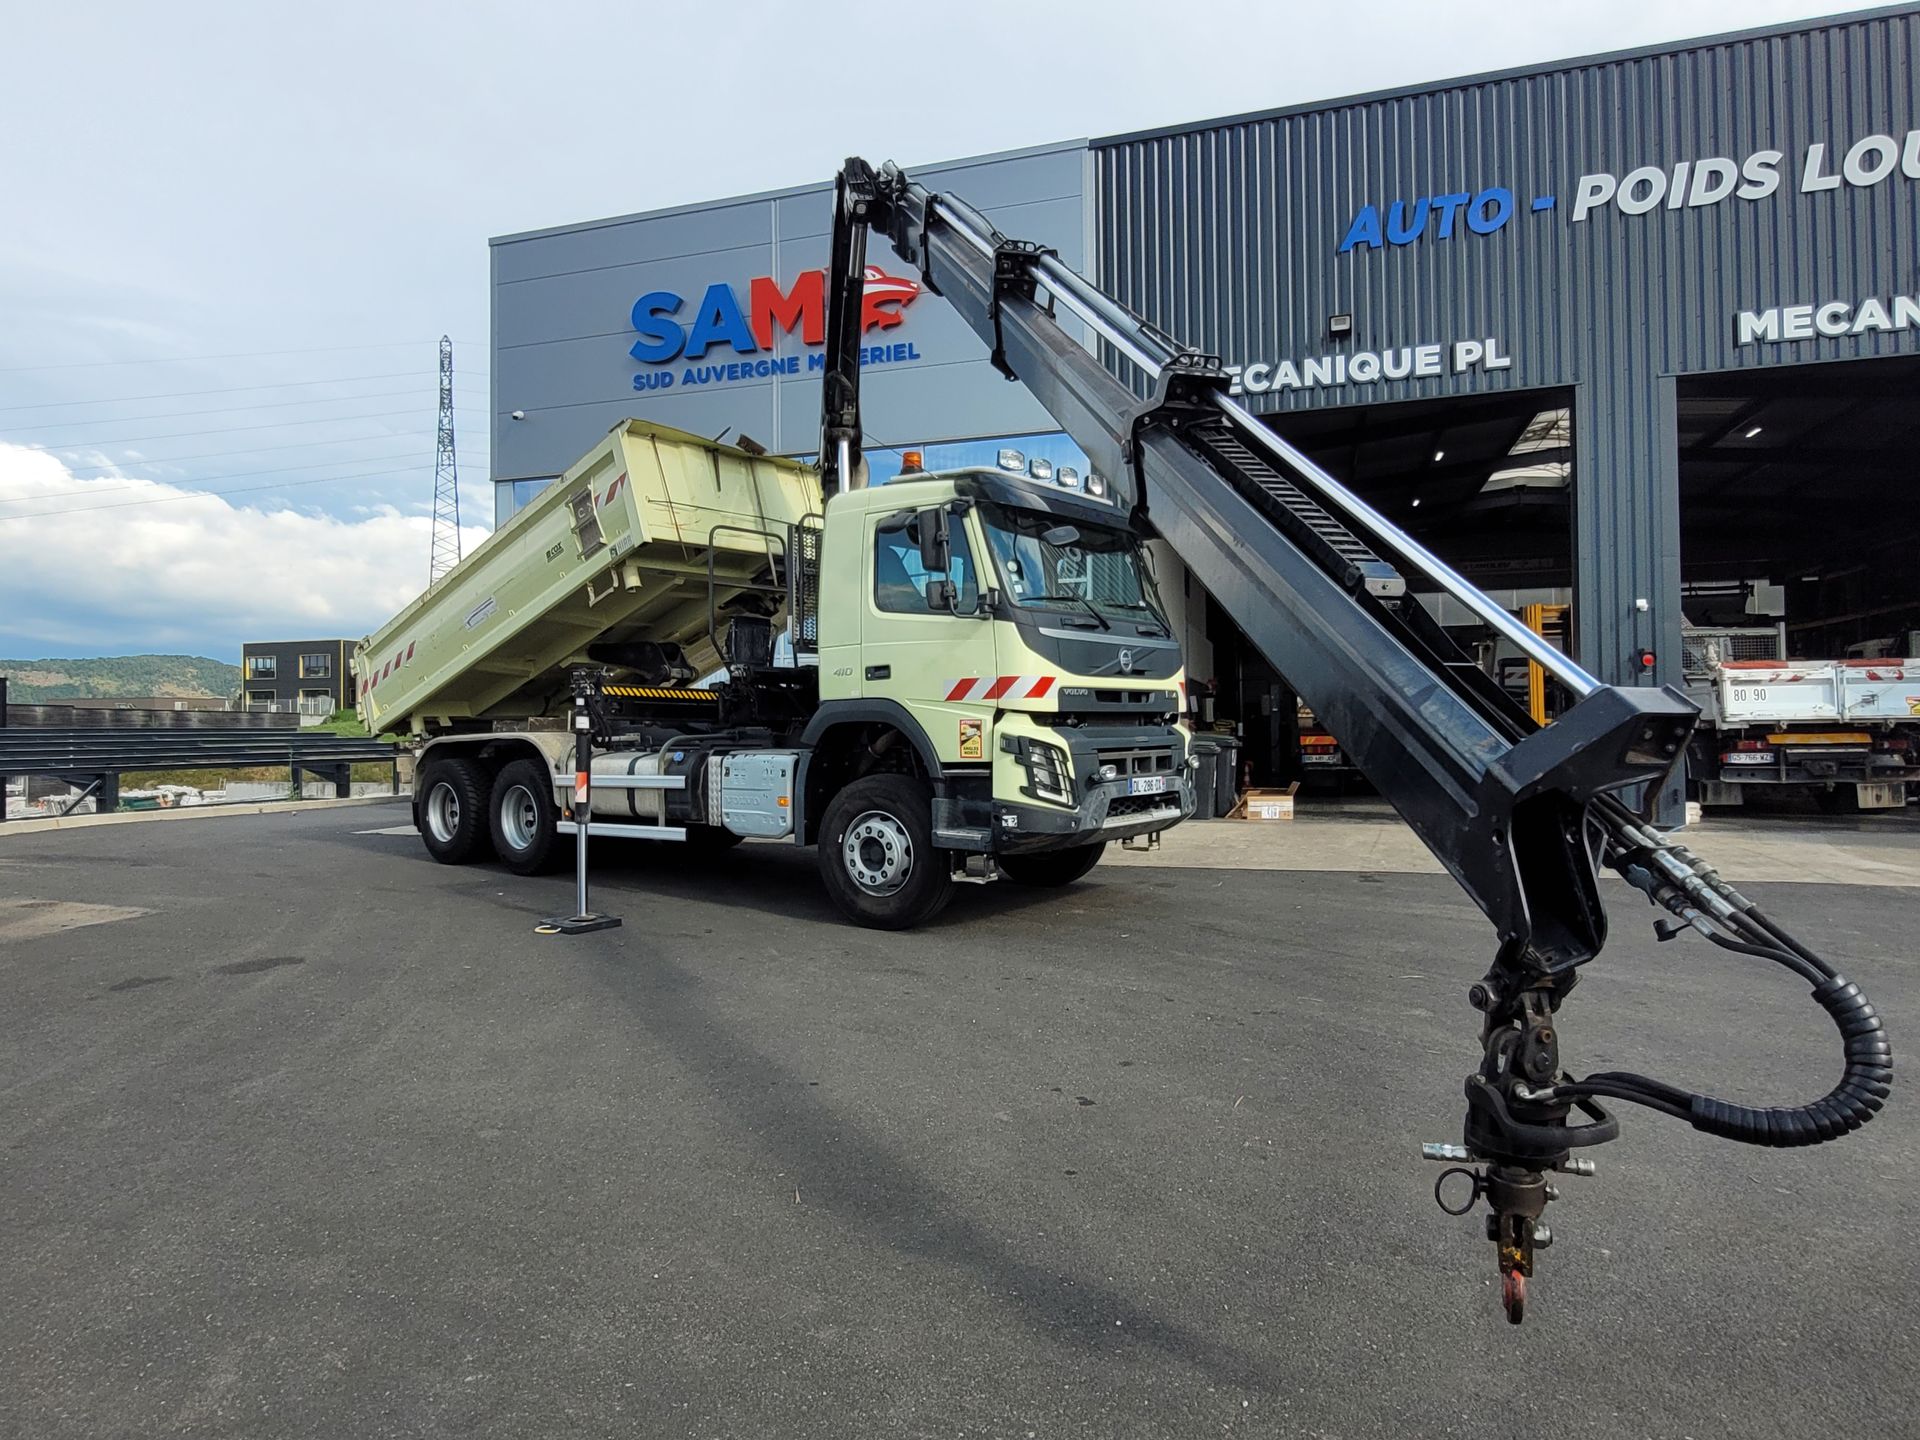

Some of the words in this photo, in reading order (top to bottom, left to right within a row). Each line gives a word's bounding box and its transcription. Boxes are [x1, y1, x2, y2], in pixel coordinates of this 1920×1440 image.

[1339, 187, 1513, 253] AUTO
[1572, 150, 1784, 222] POIDS
[629, 269, 825, 364] SAM
[1740, 295, 1920, 343] MECAN
[633, 371, 674, 391] SUD
[682, 356, 800, 385] AUVERGNE
[808, 342, 921, 371] MERIEL
[1222, 343, 1441, 395] ECANIQUE
[1455, 338, 1511, 371] PL
[833, 667, 854, 677] 410
[1733, 689, 1747, 702] 80
[1753, 688, 1767, 701] 90
